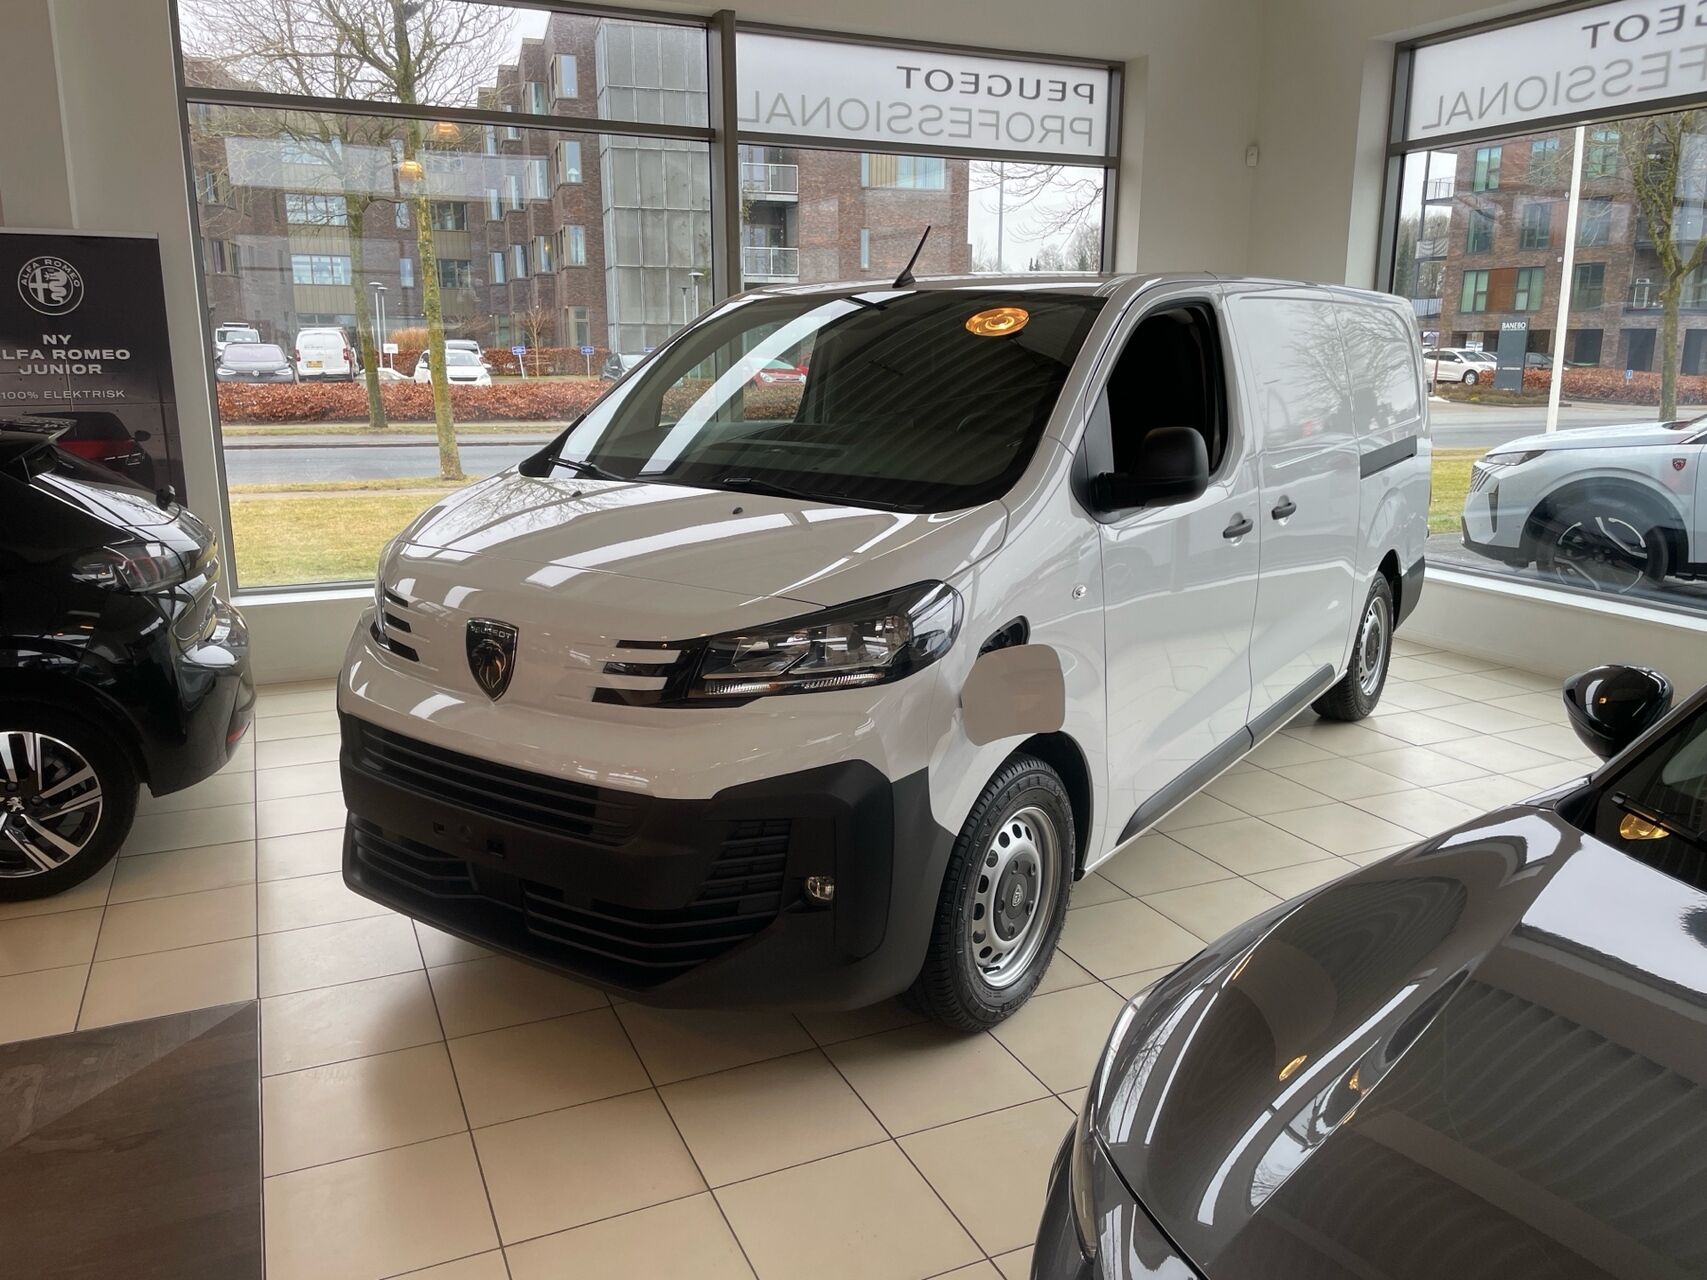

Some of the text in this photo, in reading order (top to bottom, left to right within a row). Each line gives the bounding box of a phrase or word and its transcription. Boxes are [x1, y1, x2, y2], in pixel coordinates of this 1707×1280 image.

[20, 258, 81, 288] ALFA ROMEO
[42, 334, 72, 345] NY
[0, 349, 131, 360] LFA ROMEO
[19, 364, 103, 375] JUNIOR
[1, 390, 126, 400] 100% ELEKTRISK
